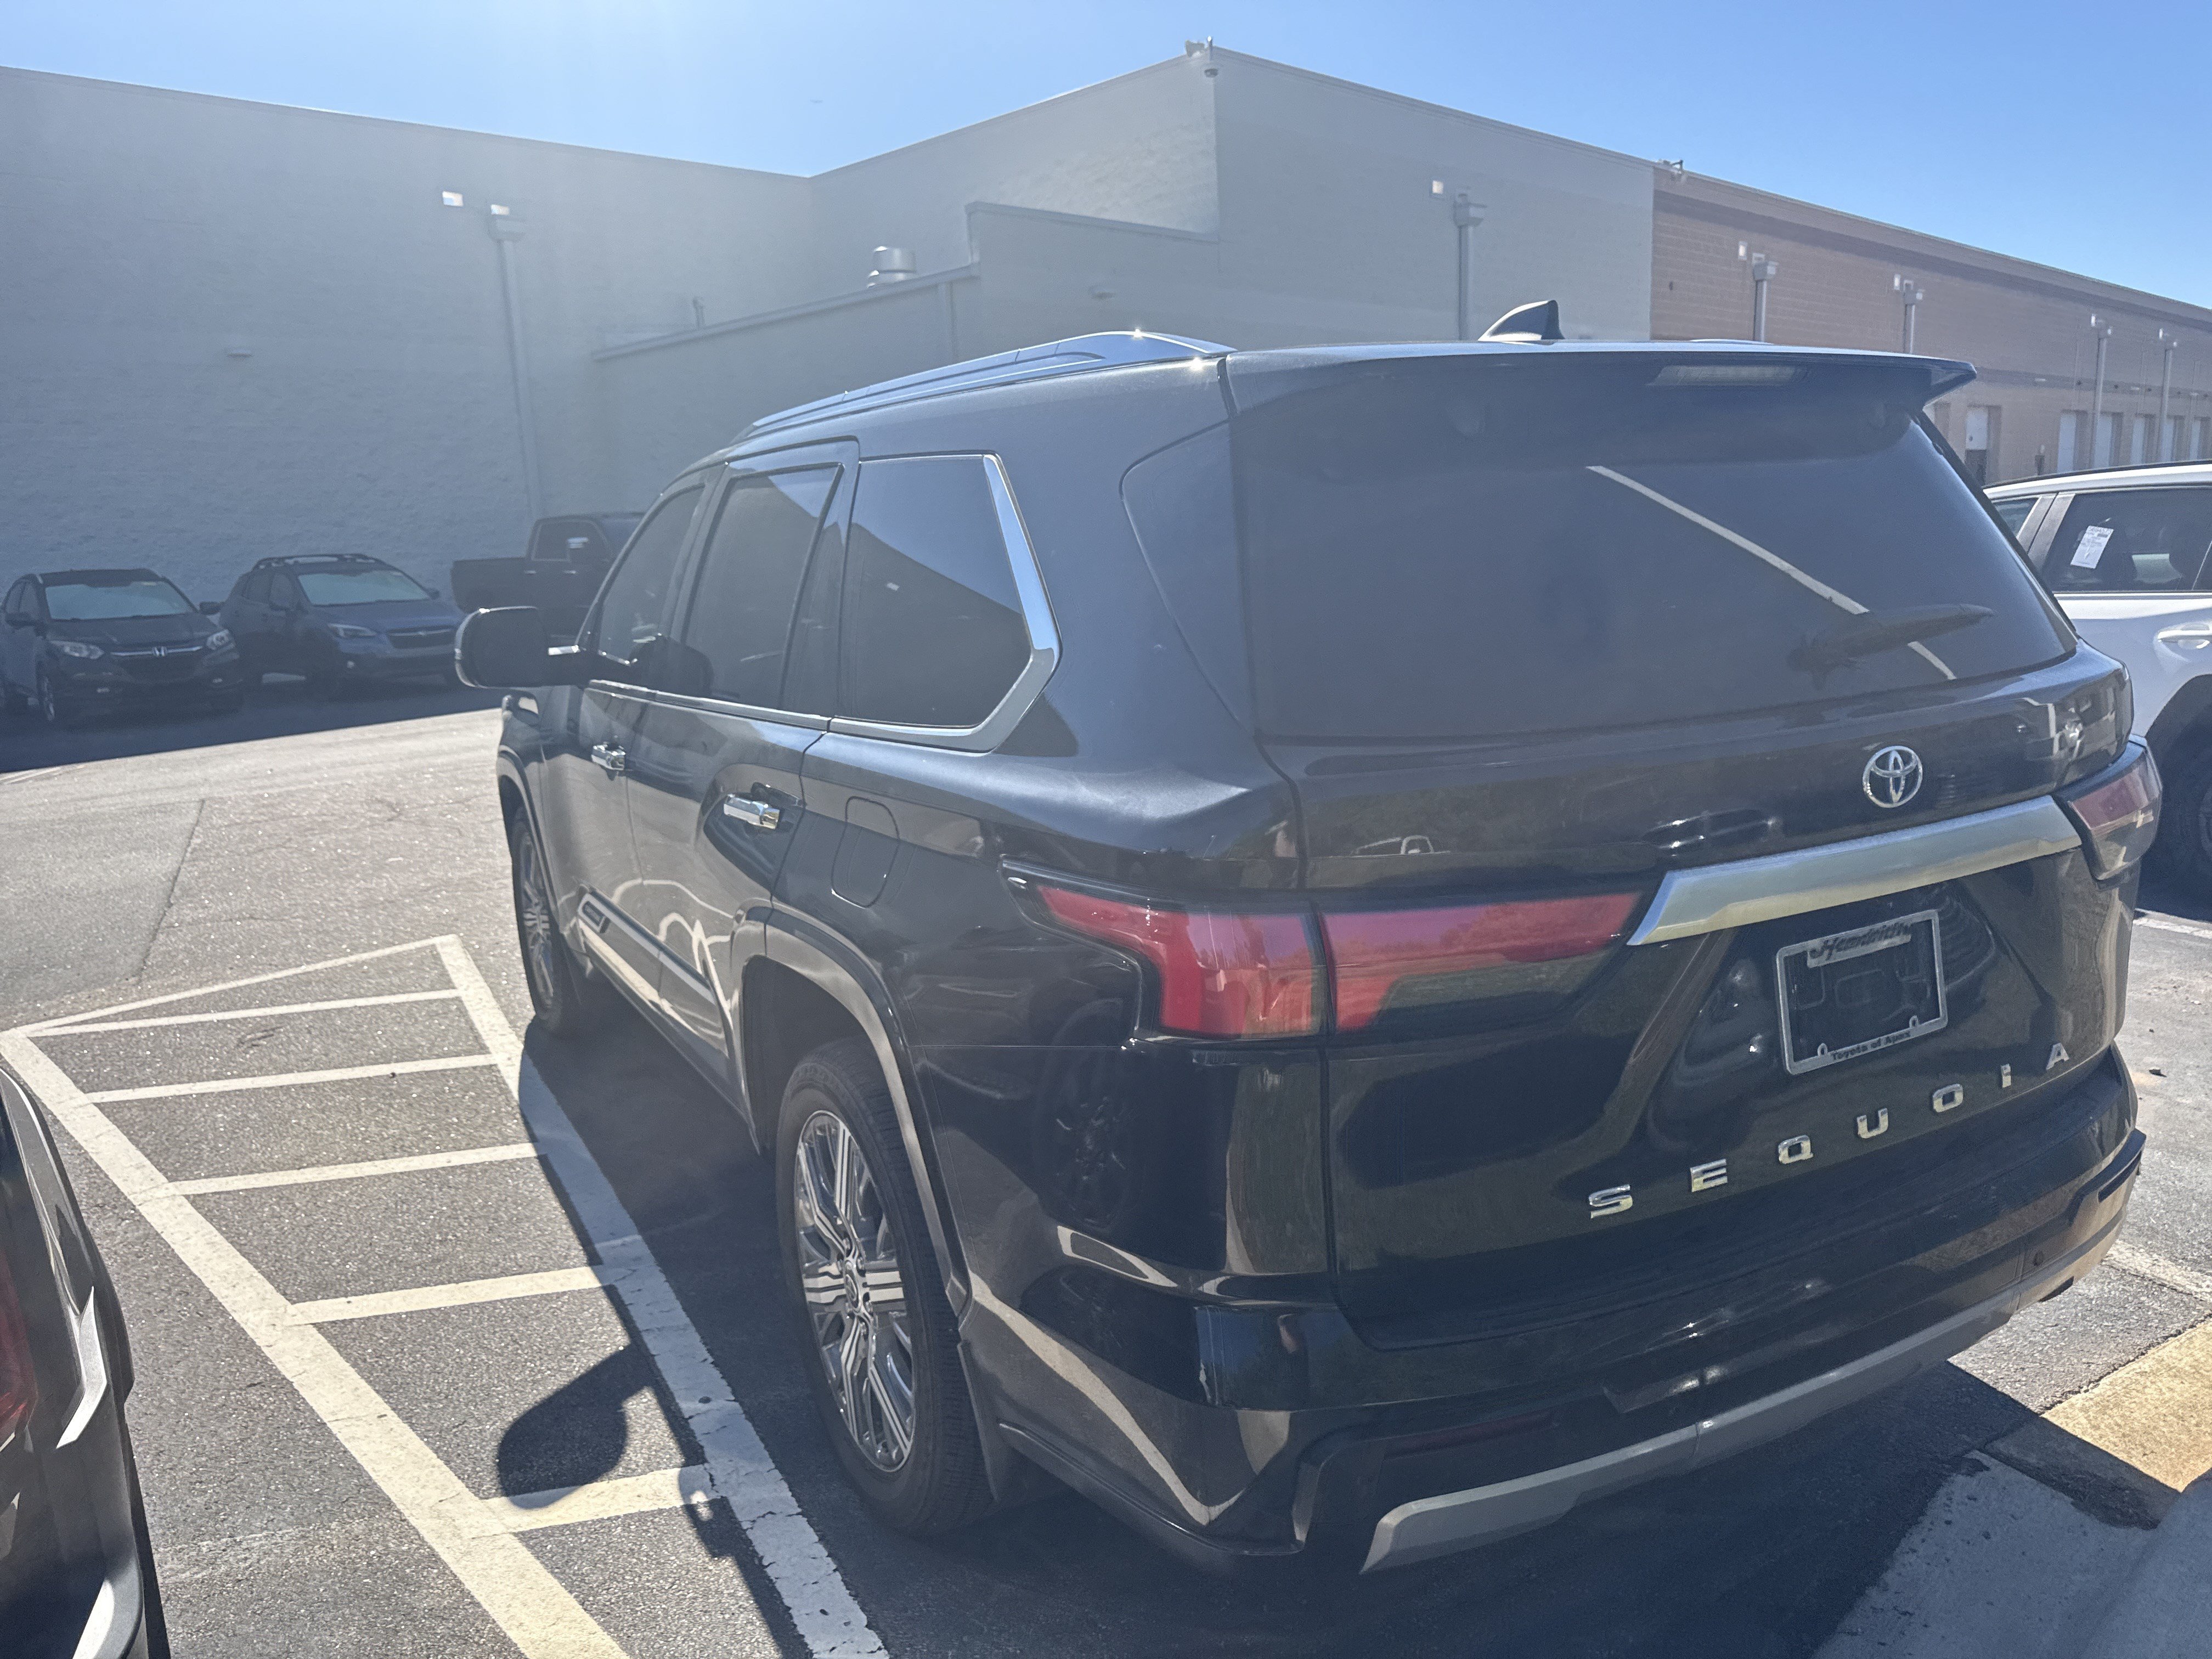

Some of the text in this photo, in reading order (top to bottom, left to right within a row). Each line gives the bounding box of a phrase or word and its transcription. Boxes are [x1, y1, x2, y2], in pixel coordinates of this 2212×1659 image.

[1830, 1044, 1868, 1060] Toyota
[1871, 1037, 1881, 1048] of
[1589, 1043, 2069, 1219] SEQUOIA
